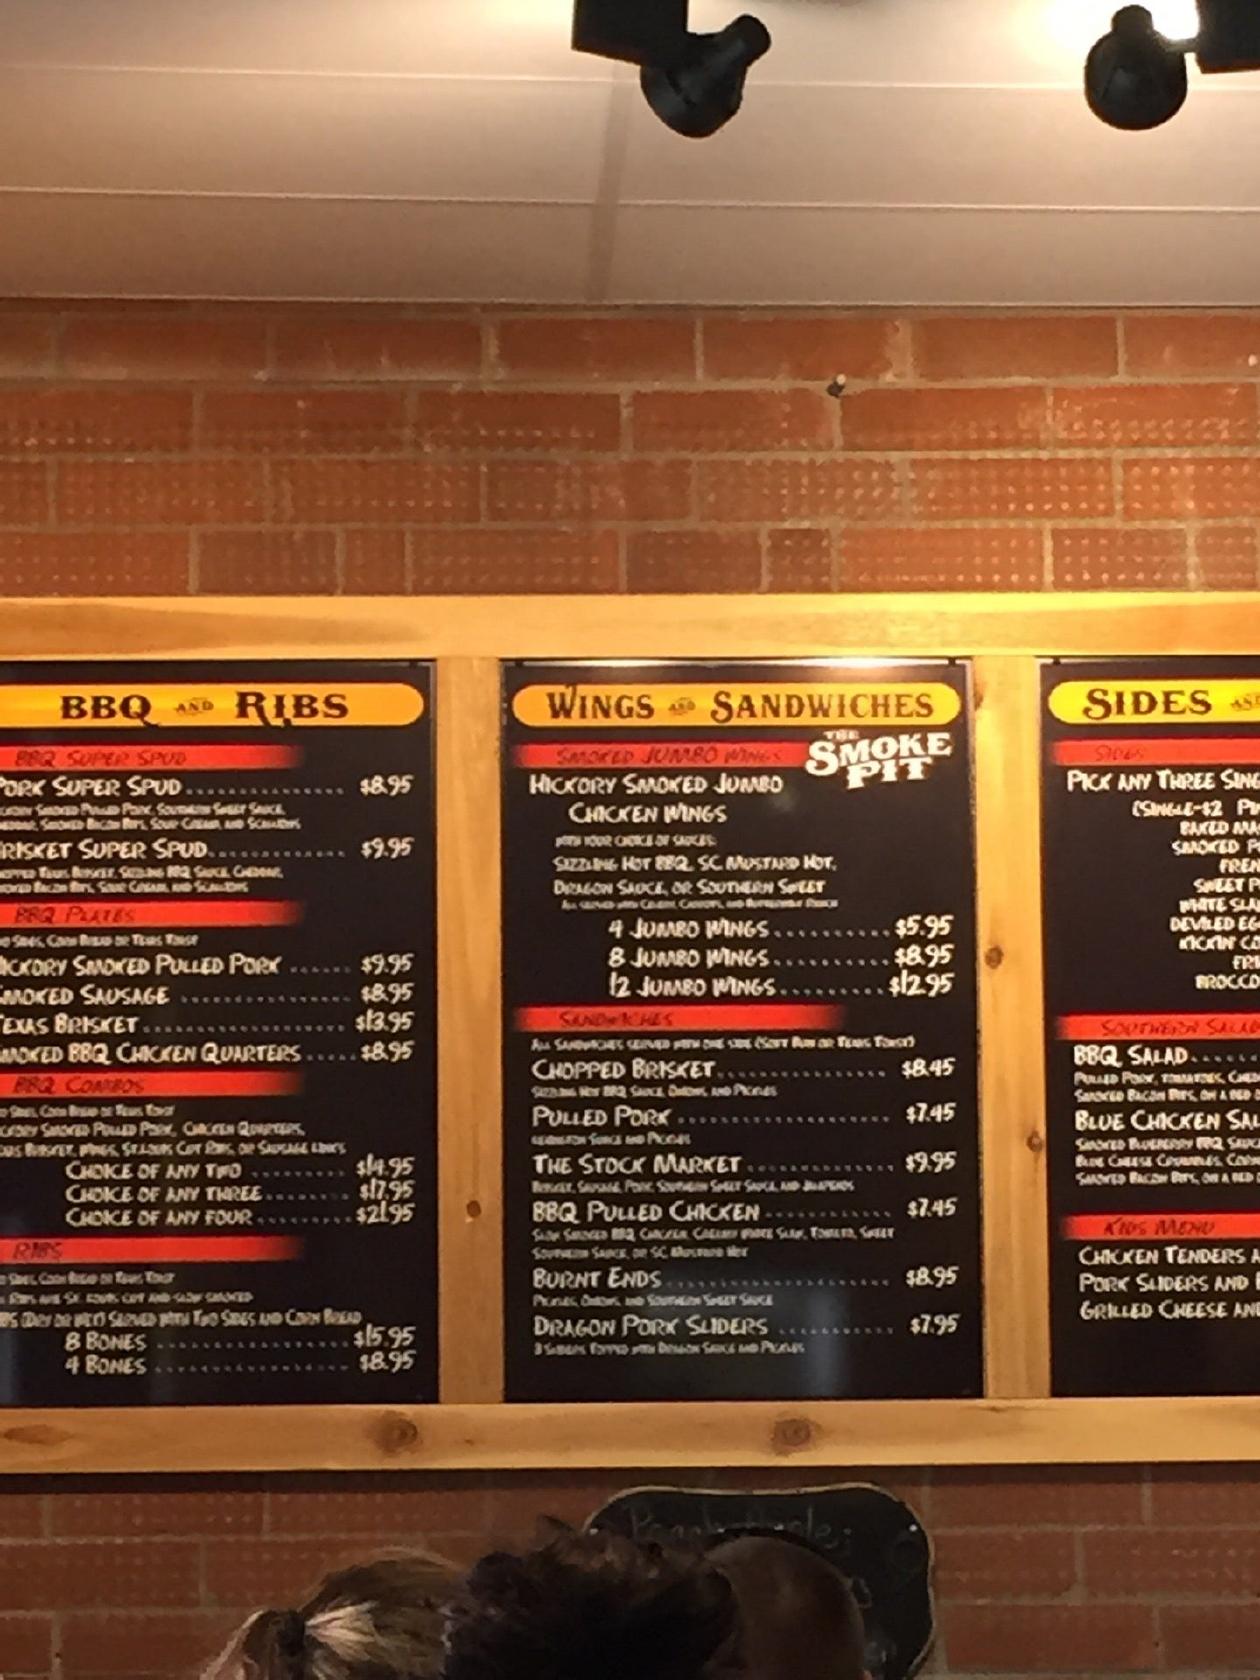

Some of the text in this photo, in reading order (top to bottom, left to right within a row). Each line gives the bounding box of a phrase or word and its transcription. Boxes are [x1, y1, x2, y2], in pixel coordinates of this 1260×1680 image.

[60, 691, 349, 727] BBQ AND RIBS
[546, 685, 934, 724] WINGS SANDWICHES
[1083, 688, 1212, 720] SIDES
[823, 729, 859, 741] THE
[15, 750, 187, 767] BBQ SUPER SPUD
[642, 746, 719, 765] JUMBO
[805, 732, 952, 776] SMOKE
[529, 773, 784, 795] HICKORY SMOKED JUMBO
[846, 757, 933, 790] PIT
[1067, 769, 1215, 791] PICK ANY THREE
[52, 775, 414, 796] SUPER SPUD $8.95
[568, 802, 728, 823] CHICKEN WINGS
[1180, 821, 1229, 836] BAKED
[0, 838, 414, 860] RISKET SUPER SPUD $9.95
[1172, 840, 1240, 855] SMOKED
[621, 855, 650, 871] HOT
[553, 880, 613, 895] DRAGON
[1193, 878, 1244, 893] SWEET
[15, 906, 136, 924] BBQ PLATES
[1179, 898, 1227, 913] WHITE
[608, 914, 954, 939] 4 JUMBO WINGS $5.95
[1170, 917, 1234, 932] DEVILED
[72, 953, 415, 976] SMOKED PULLED PORK $9.95
[608, 943, 955, 969] 8 JUMBO WINGS $8.95
[80, 984, 170, 1005] SAUSAGE
[361, 983, 415, 1004] $8.95
[608, 969, 956, 998] 12 JUMBO WINGS $12.95
[54, 1009, 415, 1034] BRISKET $13.95
[67, 1041, 416, 1065] BBQ CHICKEN QUARTERS $8.95
[1074, 1045, 1188, 1067] BBQ SALAD
[531, 1057, 956, 1080] CHOPPED BRISKET $8.45
[13, 1076, 144, 1093] BBQ COMBOS
[532, 1102, 956, 1127] PULLED PORK $7.45
[1075, 1109, 1221, 1131] BLUE CHICKEN
[65, 1153, 415, 1180] CHOICE OF ANY TWO $14.95
[533, 1151, 957, 1174] THE STOCK MARKET $9.95
[65, 1177, 416, 1203] CHOICE OF ANY THREE $17.95
[65, 1207, 133, 1227] CHOICE
[137, 1210, 162, 1226] OF
[165, 1211, 200, 1225] ANY
[205, 1209, 253, 1226] FOUR
[532, 1197, 958, 1224] BBQ PULLED CHICKEN $7.45
[1103, 1217, 1215, 1235] KIDS MENU
[12, 1242, 63, 1260] RIBS
[1078, 1245, 1246, 1265] CHICKEN TENDERS
[532, 1266, 959, 1289] BURNT ENDS $8.95
[1079, 1273, 1250, 1292] PORK SLIDERS AND
[1080, 1300, 1228, 1320] GRILLED CHEESE
[534, 1314, 959, 1337] DRAGON PORK SLIDERS $7.95
[65, 1323, 416, 1351] 8 BONES $15.95
[64, 1350, 416, 1375] 4 BONES $8.95
